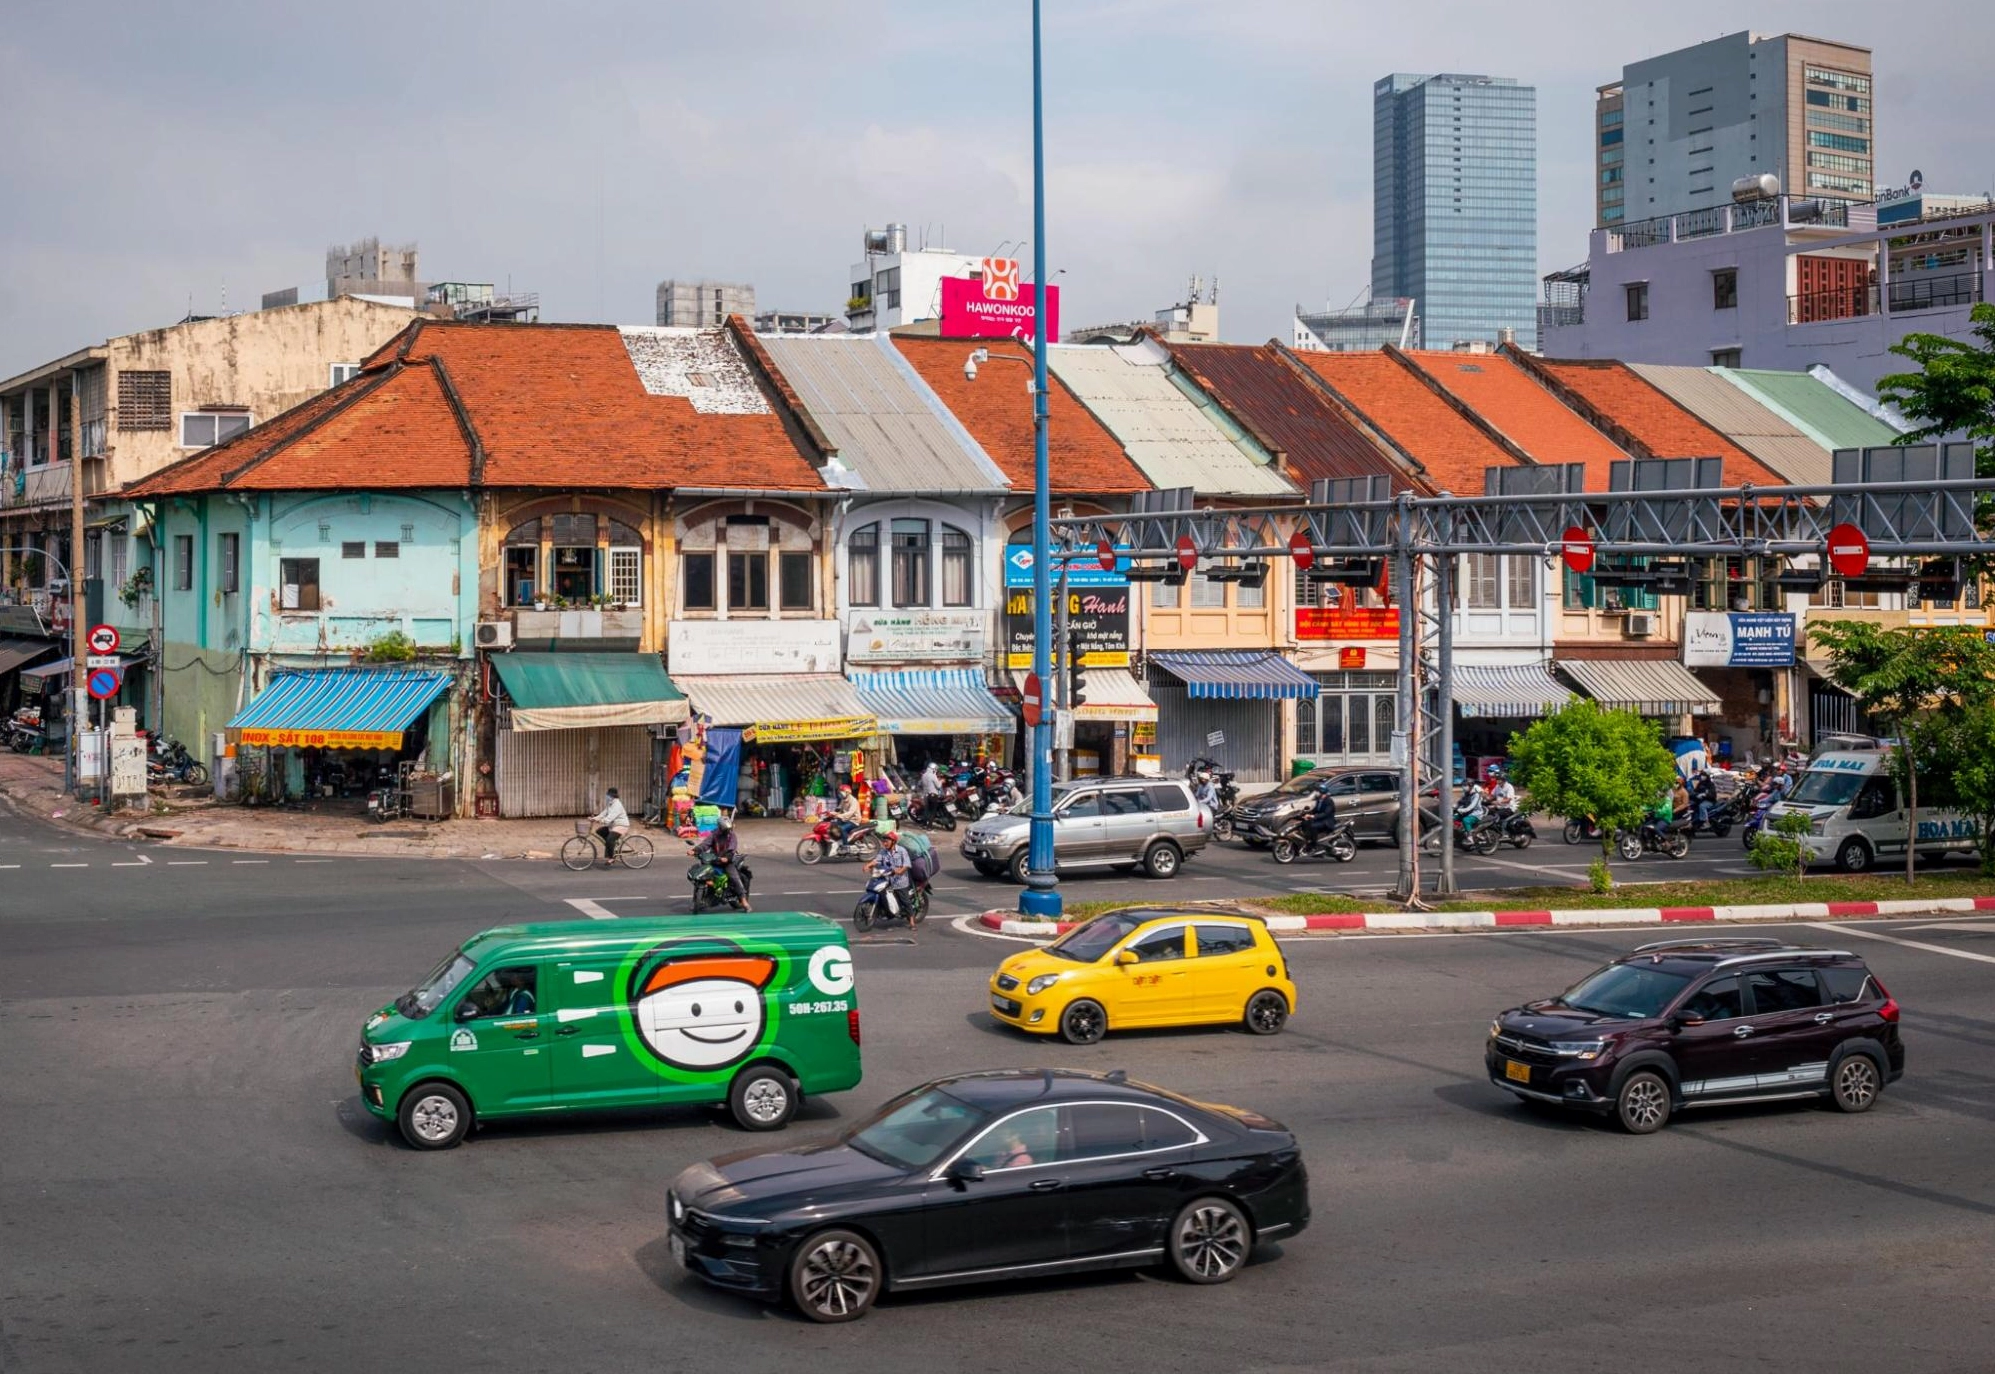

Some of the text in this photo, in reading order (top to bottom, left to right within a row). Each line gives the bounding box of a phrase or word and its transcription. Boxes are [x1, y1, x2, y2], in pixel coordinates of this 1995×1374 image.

[966, 301, 1035, 317] HAWONKOO
[1082, 595, 1126, 619] Hạnh
[1737, 623, 1791, 641] MẠNH TÚ
[242, 732, 269, 743] INOX
[305, 734, 325, 744] 108
[808, 945, 854, 995] G
